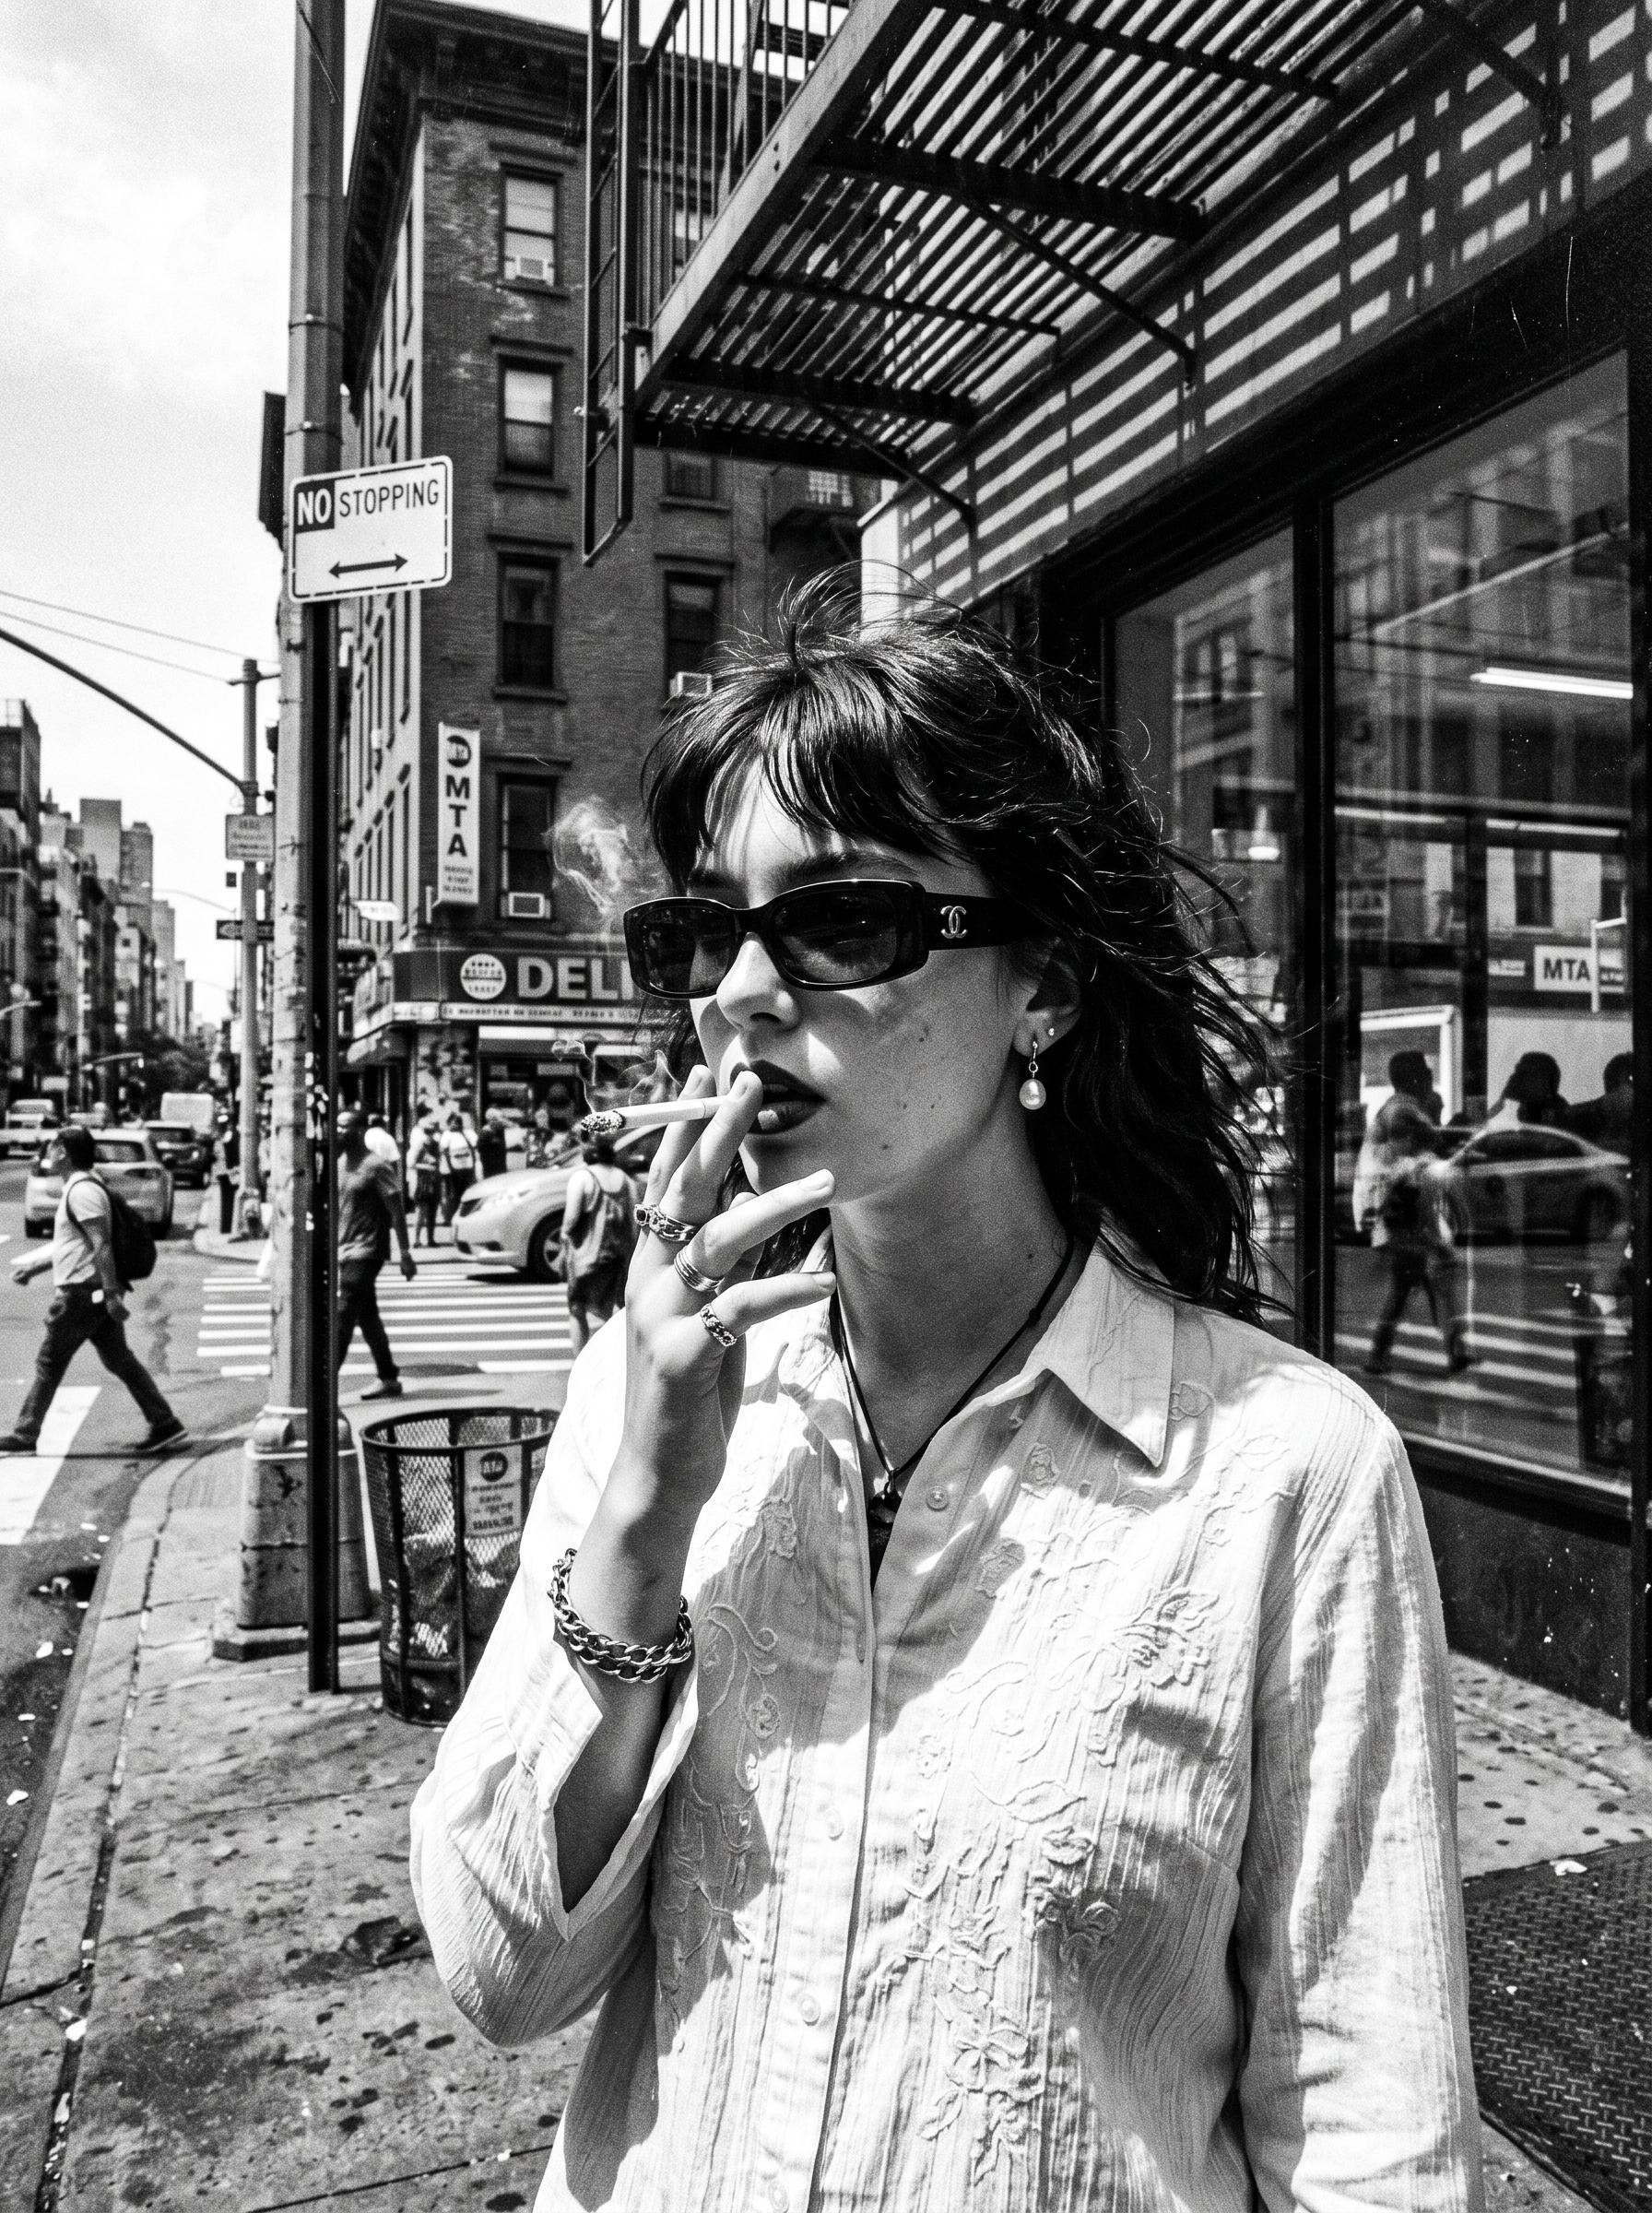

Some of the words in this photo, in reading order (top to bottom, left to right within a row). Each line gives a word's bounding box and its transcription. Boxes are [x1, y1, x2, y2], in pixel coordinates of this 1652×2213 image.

[297, 488, 333, 527] NO
[339, 479, 439, 518] STOPPING
[517, 956, 634, 1000] DELI
[1543, 957, 1591, 981] MTA
